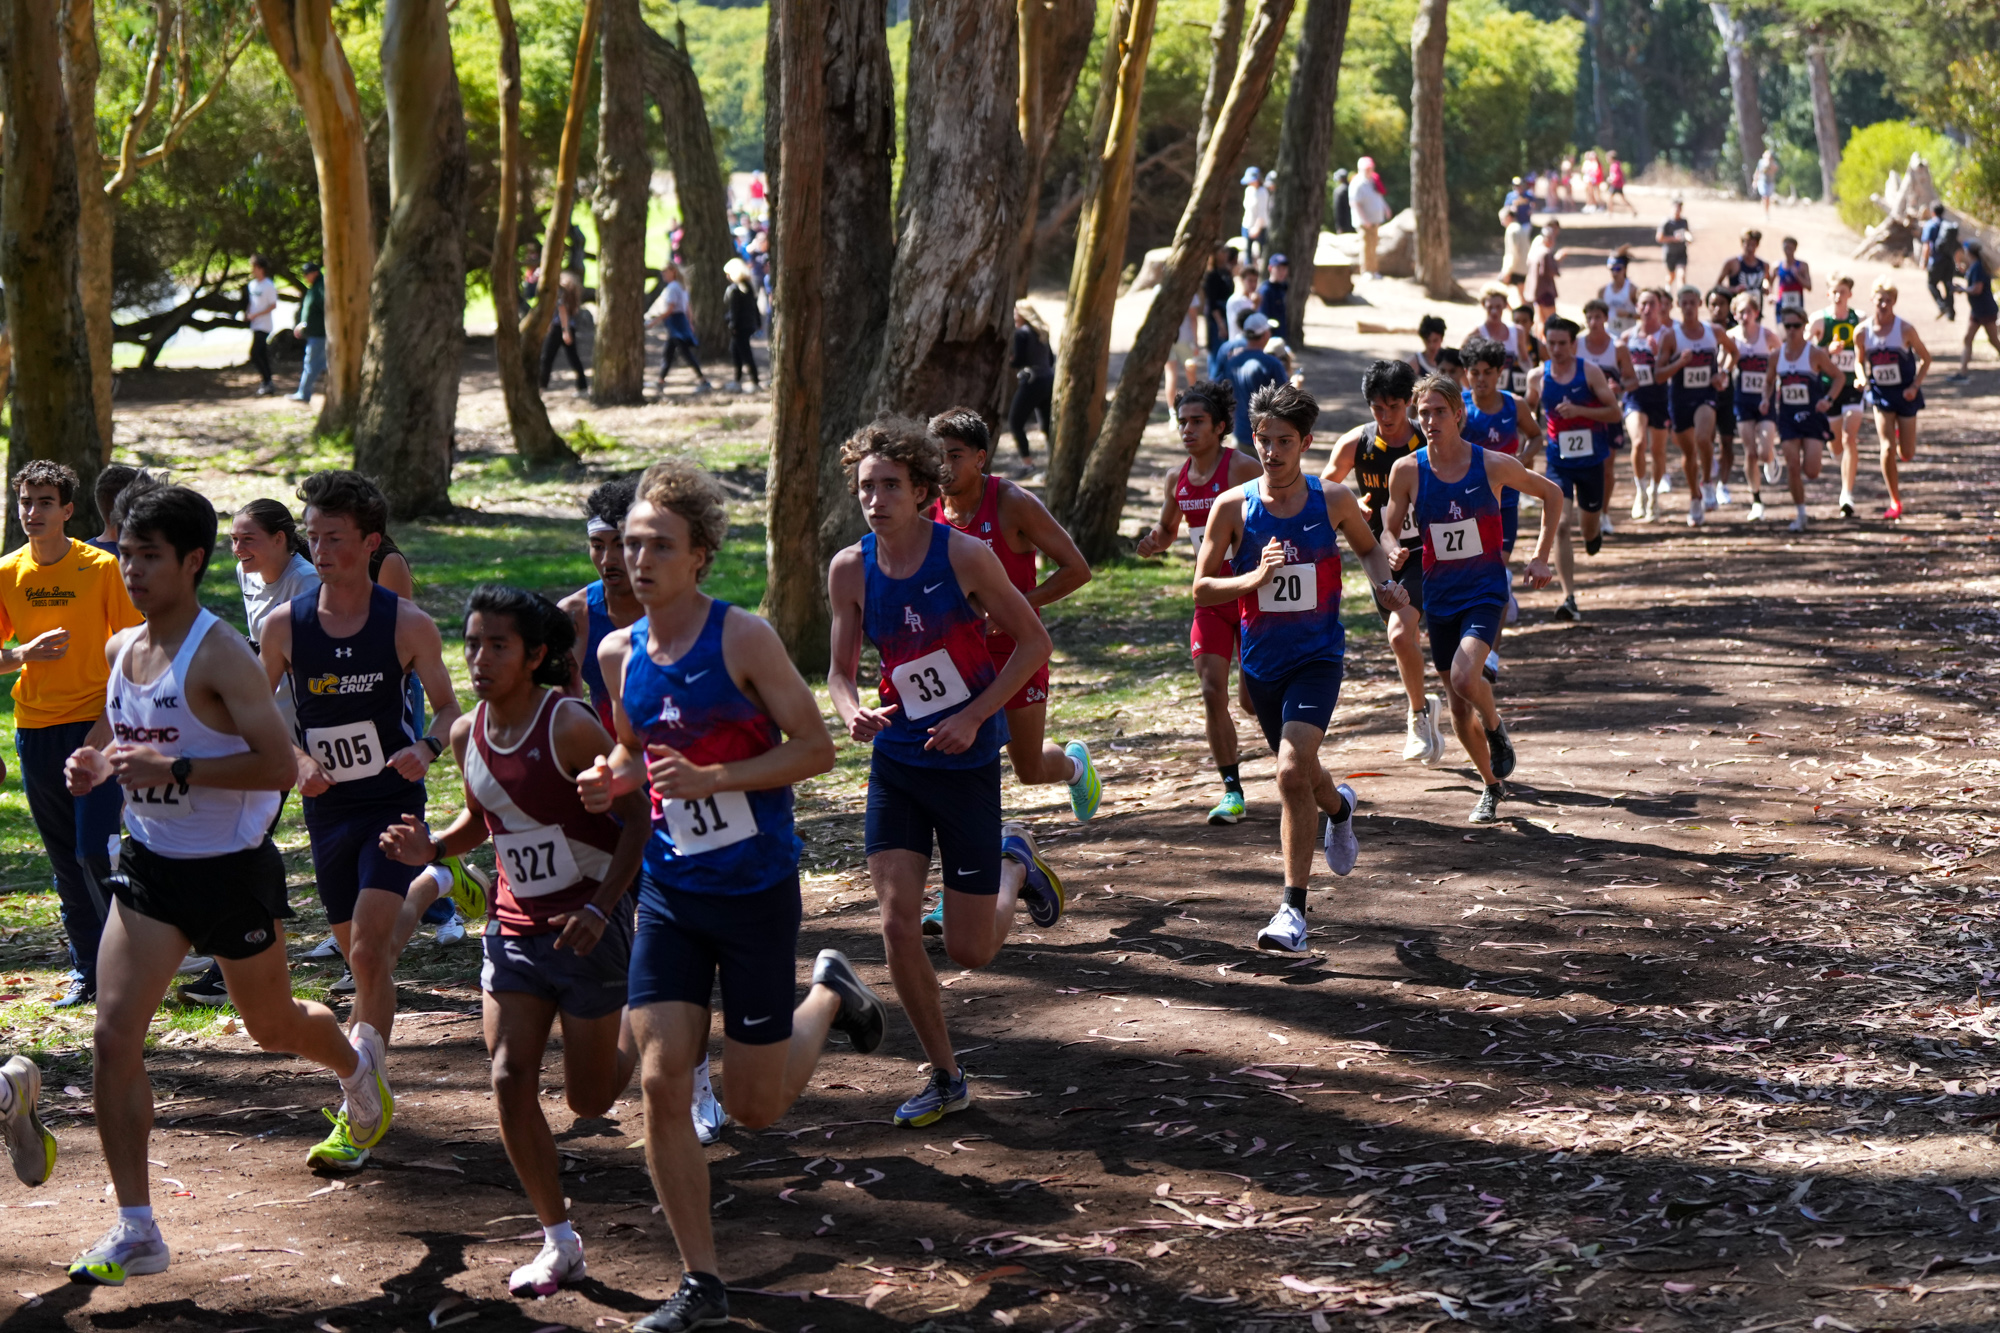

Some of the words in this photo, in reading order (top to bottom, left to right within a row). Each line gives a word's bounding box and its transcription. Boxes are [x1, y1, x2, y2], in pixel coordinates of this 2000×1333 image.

[1688, 371, 1708, 384] 240
[1745, 375, 1763, 389] 242
[1786, 388, 1804, 400] 234
[1567, 435, 1584, 452] 22
[1363, 472, 1380, 488] SAN
[1178, 498, 1204, 511] FRESNO
[1204, 497, 1217, 509] ST
[1443, 529, 1465, 552] 27
[25, 587, 51, 601] Golden
[52, 586, 76, 598] Bears
[1272, 575, 1302, 602] 20
[340, 672, 384, 686] SANTA
[909, 667, 947, 702] 33
[339, 682, 374, 695] CRUZ
[154, 696, 179, 708] WCC
[317, 733, 372, 771] 305
[684, 796, 729, 837] 31
[507, 841, 557, 883] 327
